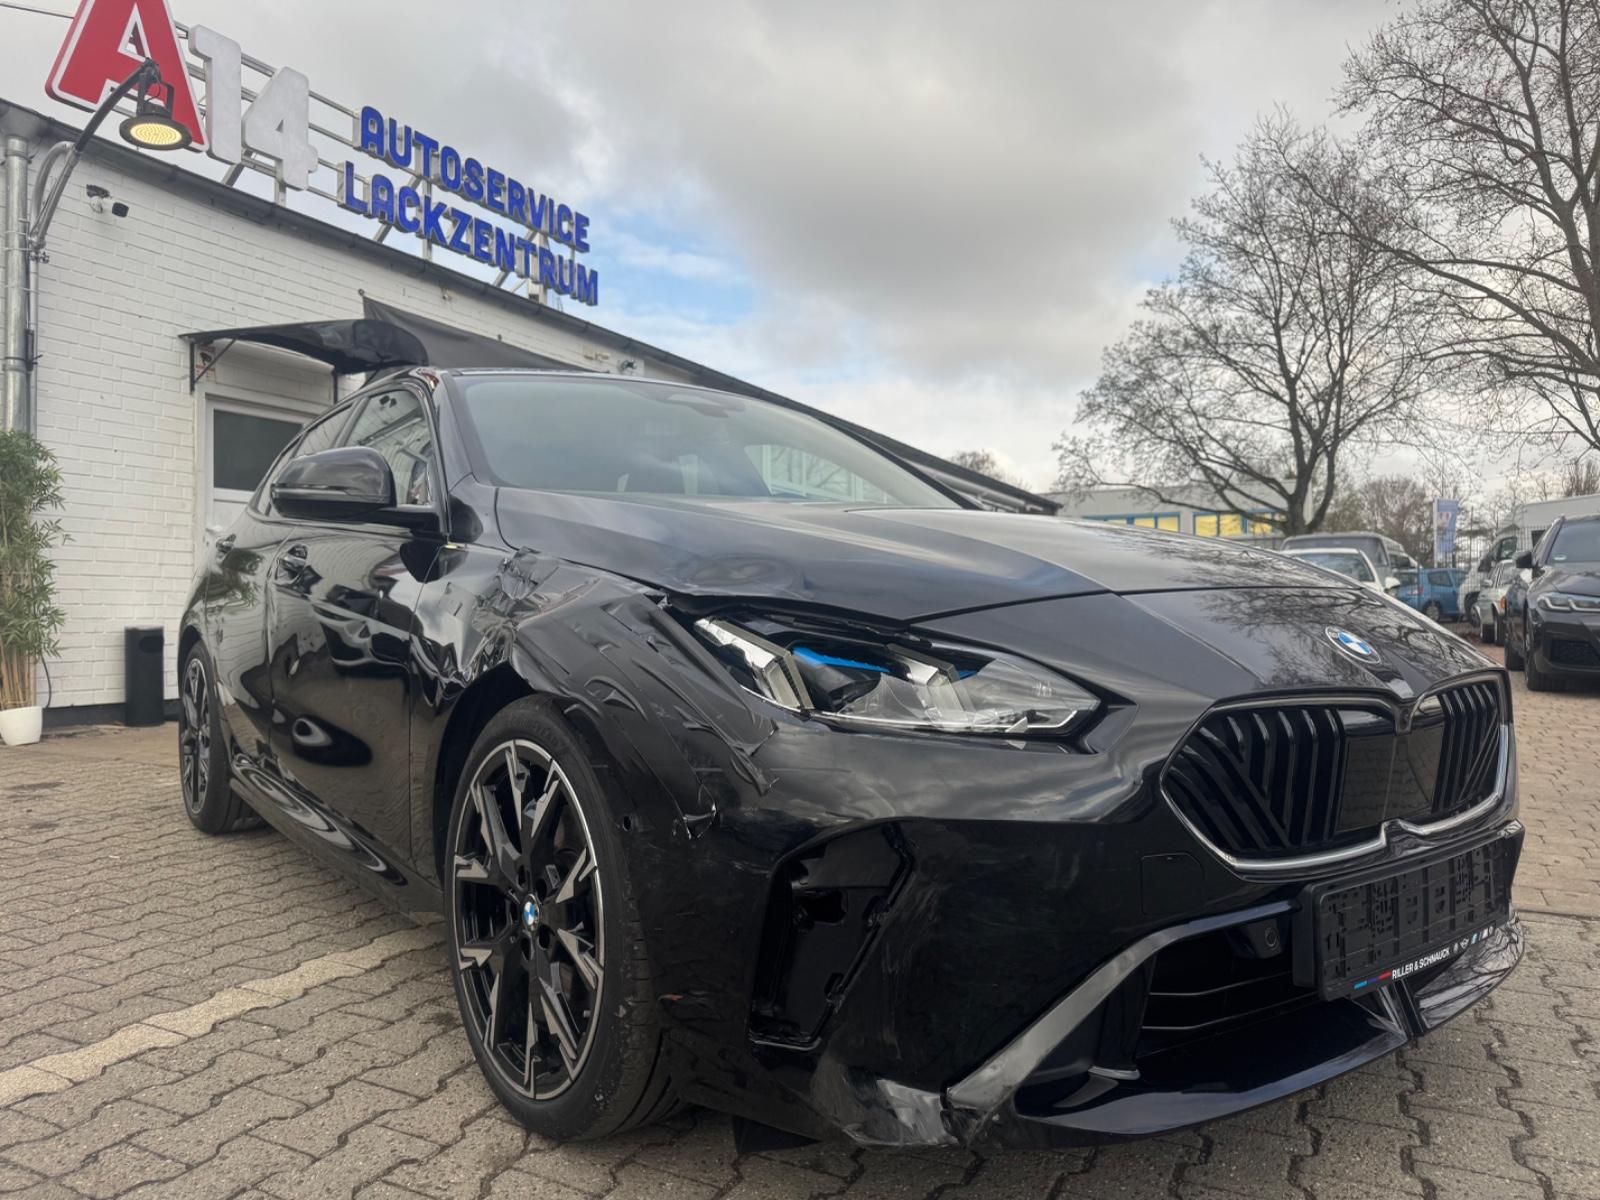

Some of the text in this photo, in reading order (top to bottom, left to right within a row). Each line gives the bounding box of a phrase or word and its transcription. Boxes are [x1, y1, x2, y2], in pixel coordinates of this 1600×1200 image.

[344, 160, 598, 306] LACKZENTRUM
[361, 105, 590, 252] AUTOSERVICE
[1392, 947, 1450, 980] RILLER & SCHNAUCK
